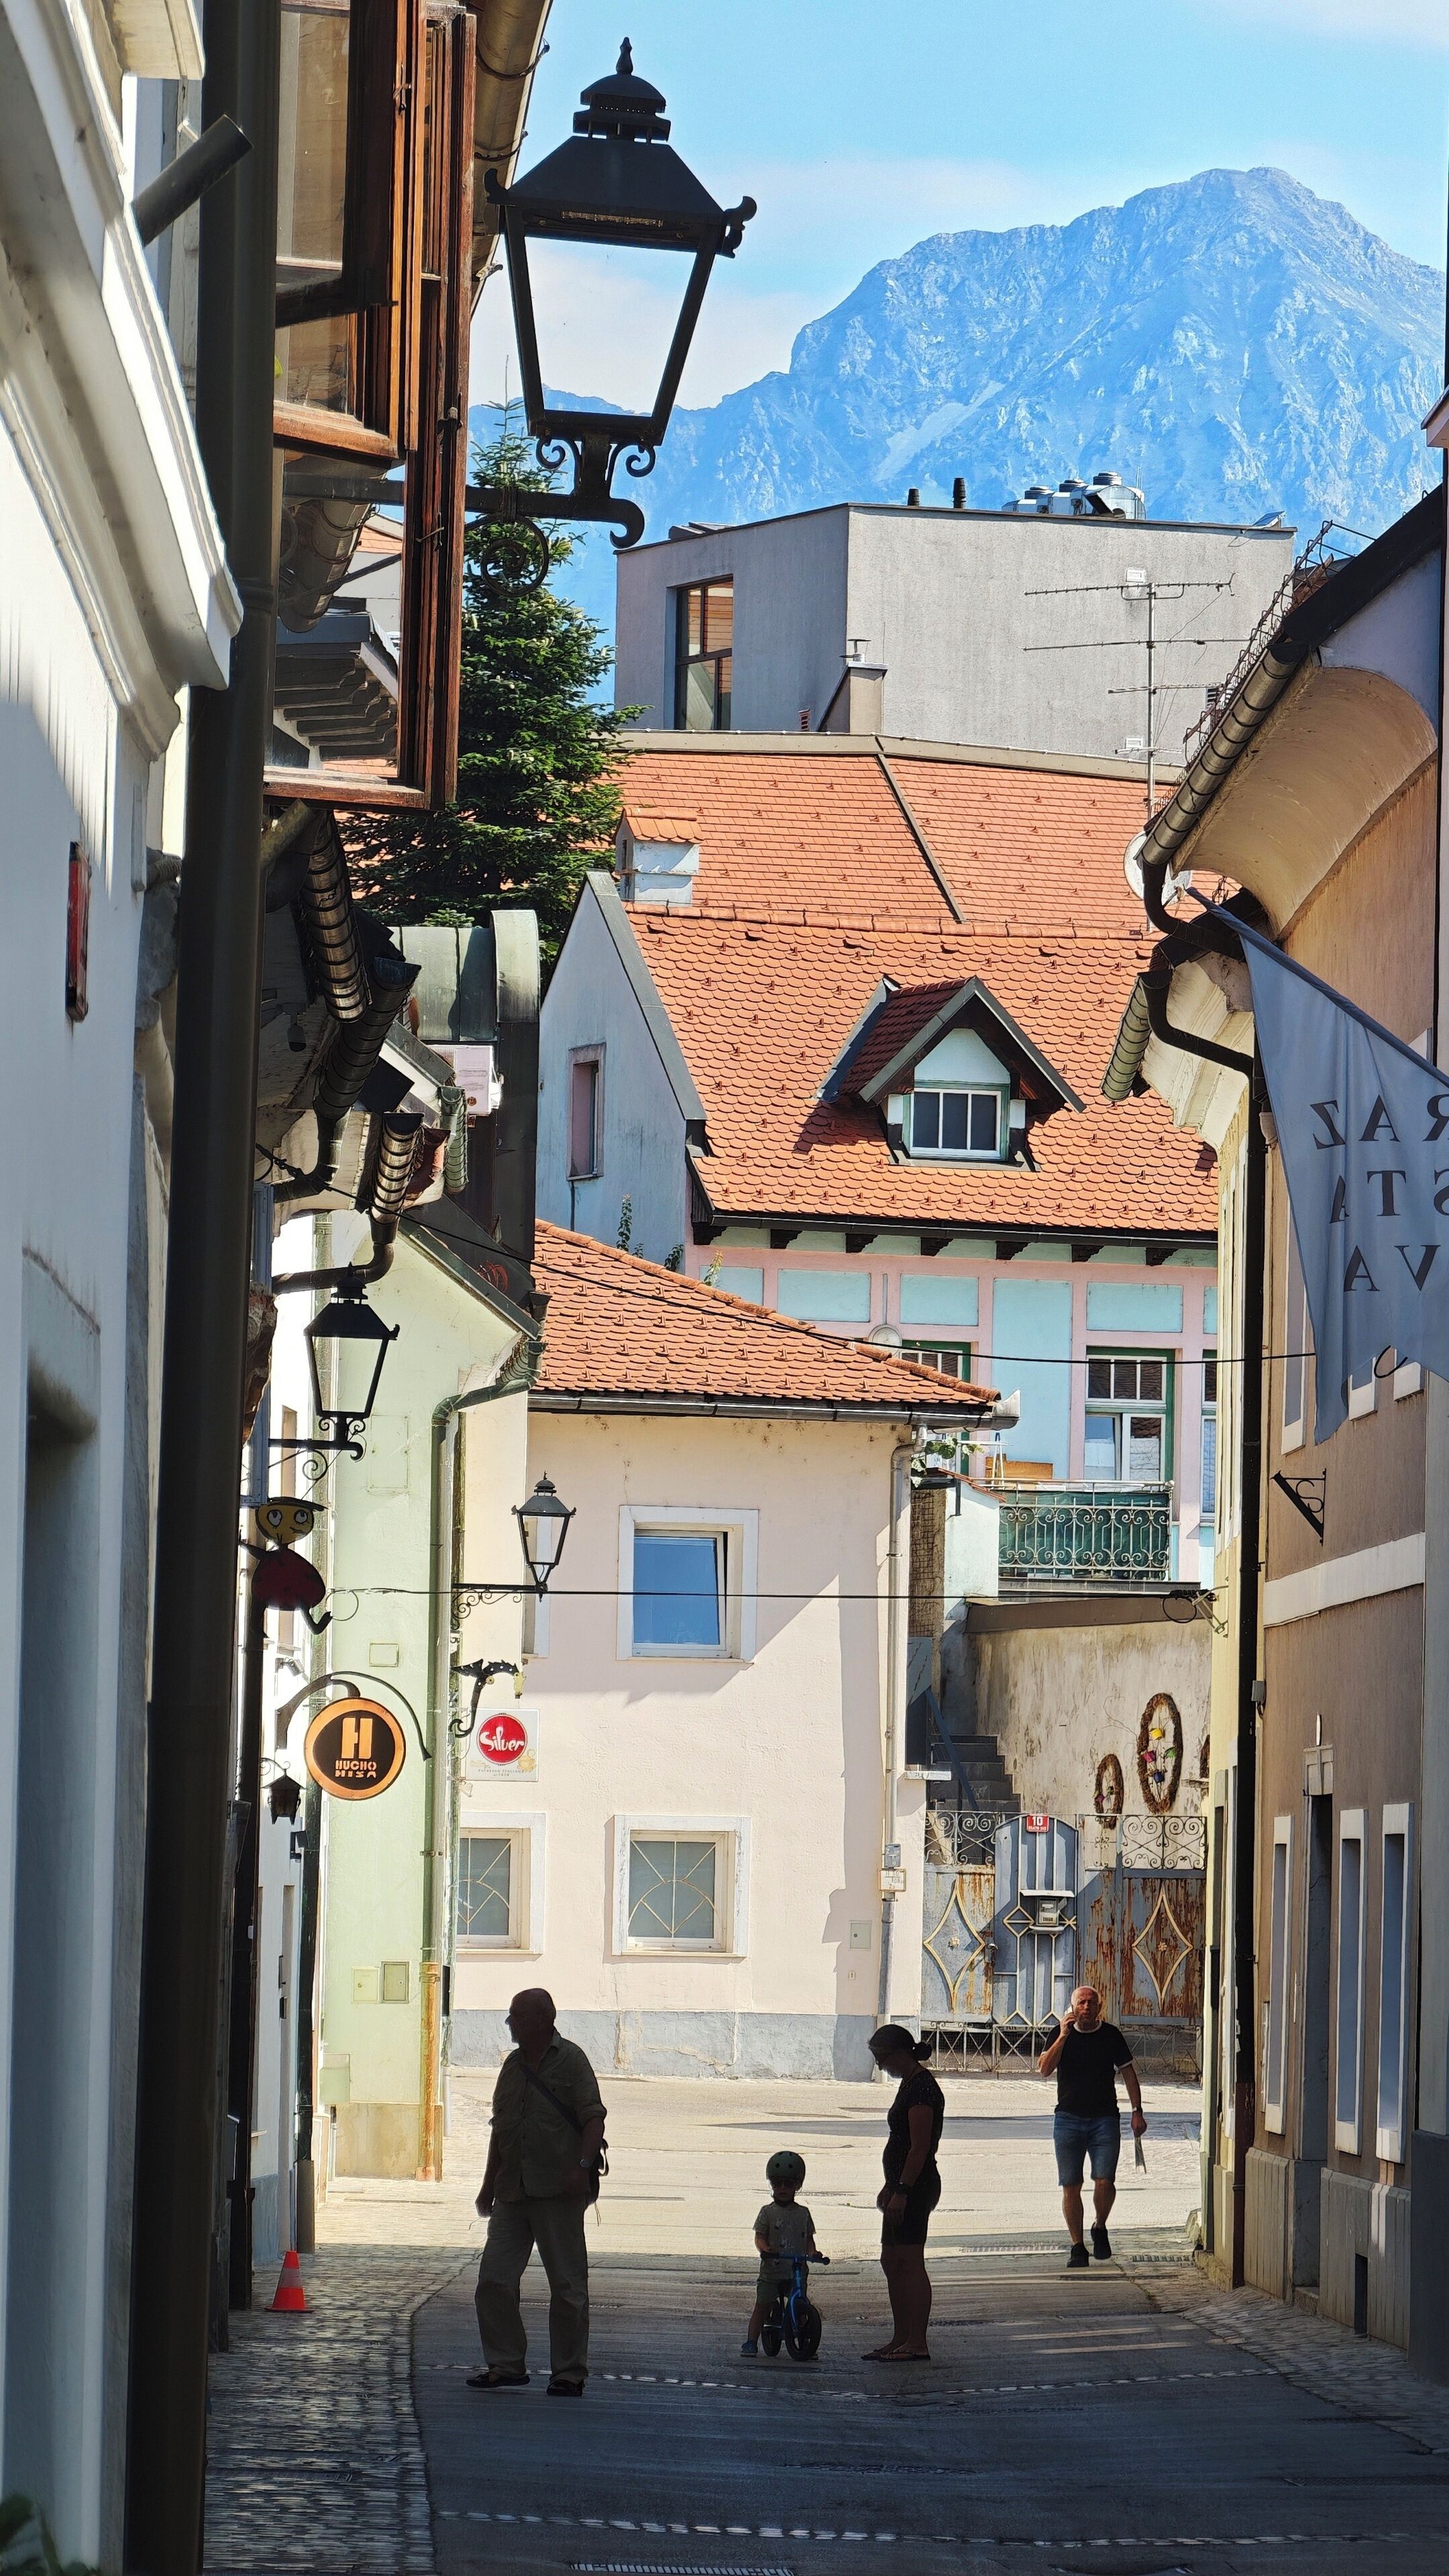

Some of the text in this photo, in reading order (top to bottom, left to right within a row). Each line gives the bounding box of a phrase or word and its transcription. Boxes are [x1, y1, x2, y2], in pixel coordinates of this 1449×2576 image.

[480, 1726, 525, 1752] Silver
[335, 1760, 377, 1770] HUCHO
[1032, 1816, 1043, 1826] 10
